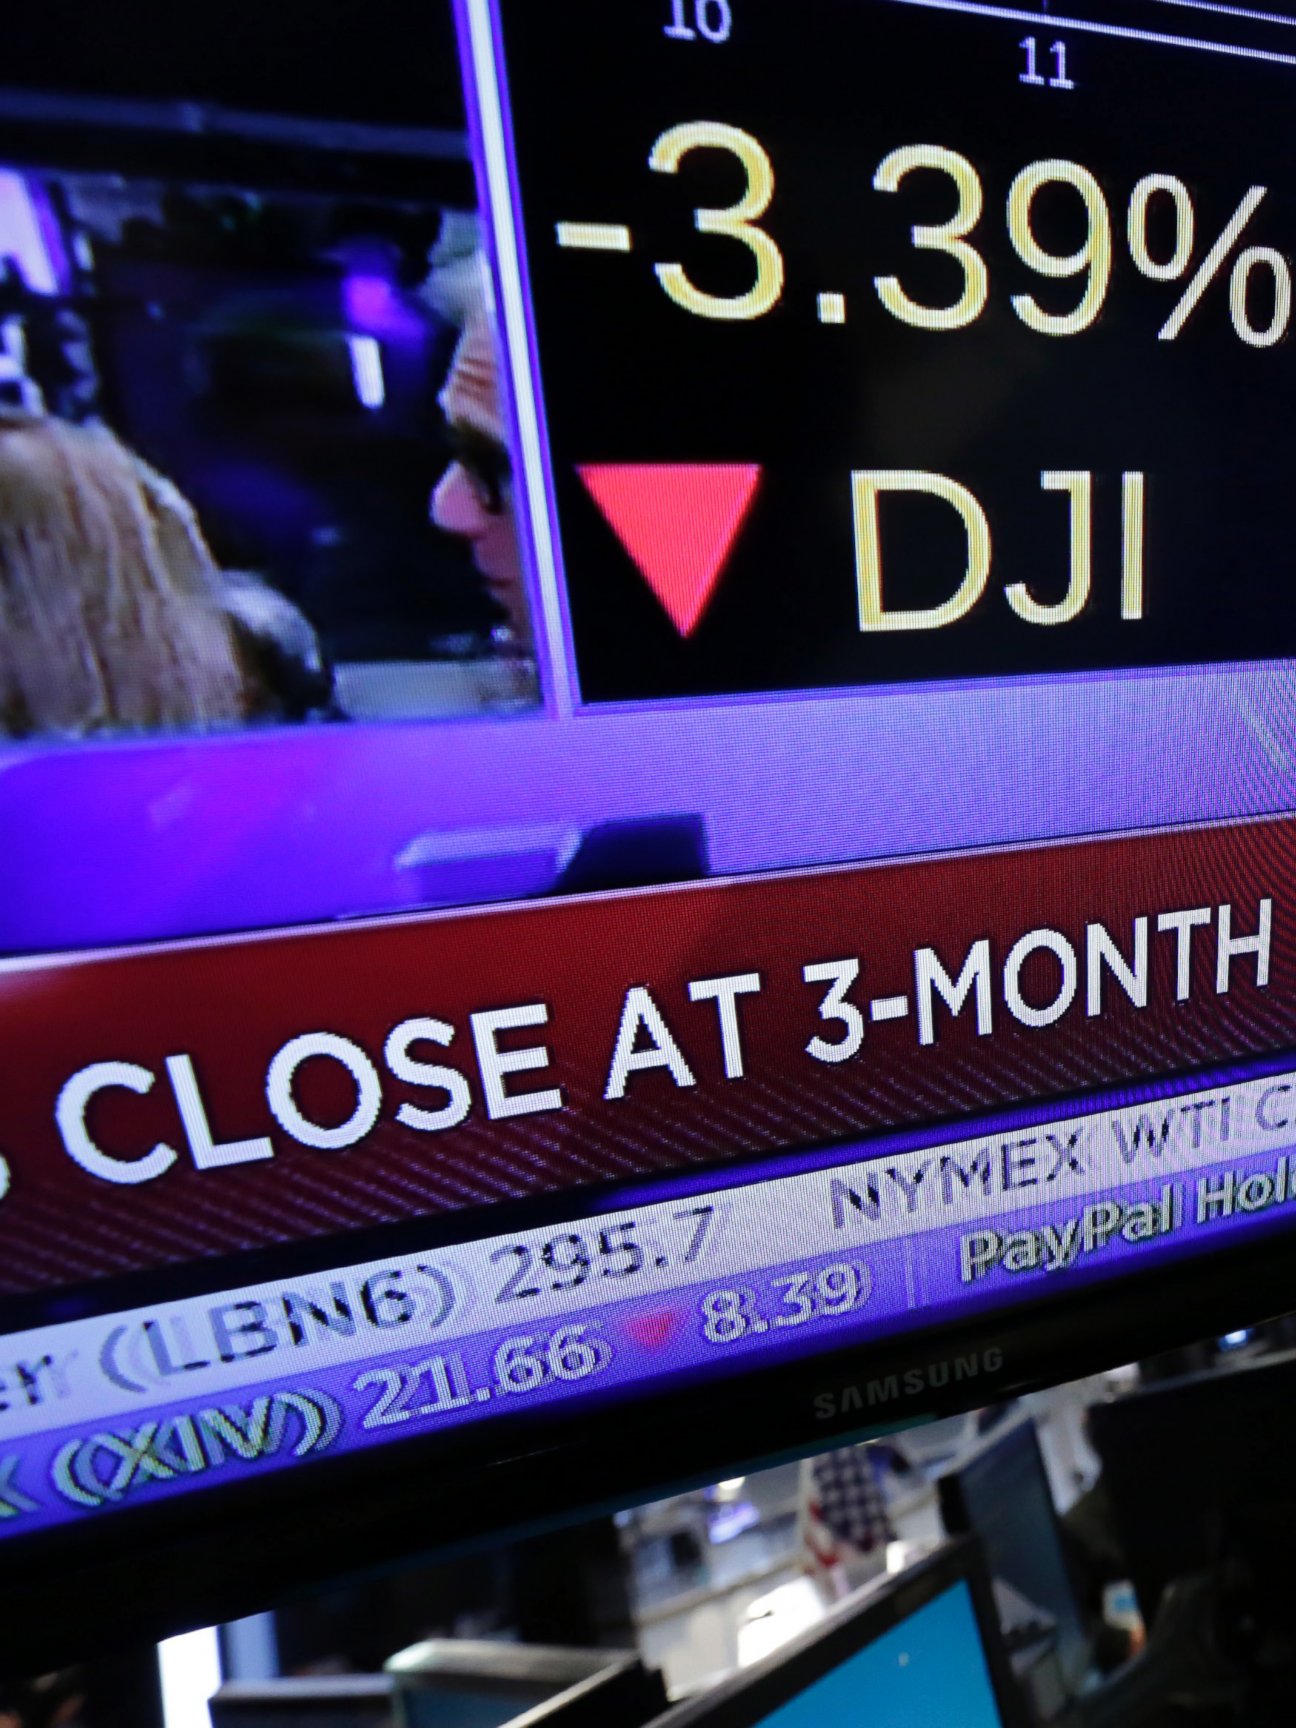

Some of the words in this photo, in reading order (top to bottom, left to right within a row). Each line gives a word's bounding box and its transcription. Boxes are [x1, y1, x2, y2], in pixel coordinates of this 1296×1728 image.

[662, 0, 732, 44] 10
[1018, 36, 1075, 90] 11
[556, 120, 1292, 348] -3.39%
[850, 469, 1146, 633] DJI
[55, 1002, 563, 1185] CLOSE
[603, 972, 762, 1101] AT
[802, 898, 1273, 1066] 3-MONTH
[52, 1388, 343, 1506] (XIV)
[353, 1323, 615, 1430] 21.66
[703, 1259, 873, 1343] 8.39
[959, 1182, 1181, 1284] PayPal
[100, 1263, 455, 1393] (LBN6)
[488, 1205, 715, 1303] 295.7
[829, 1126, 1086, 1230] NYMEX
[1111, 1096, 1230, 1166] WTI
[813, 1347, 1003, 1421] SAMSUNG
